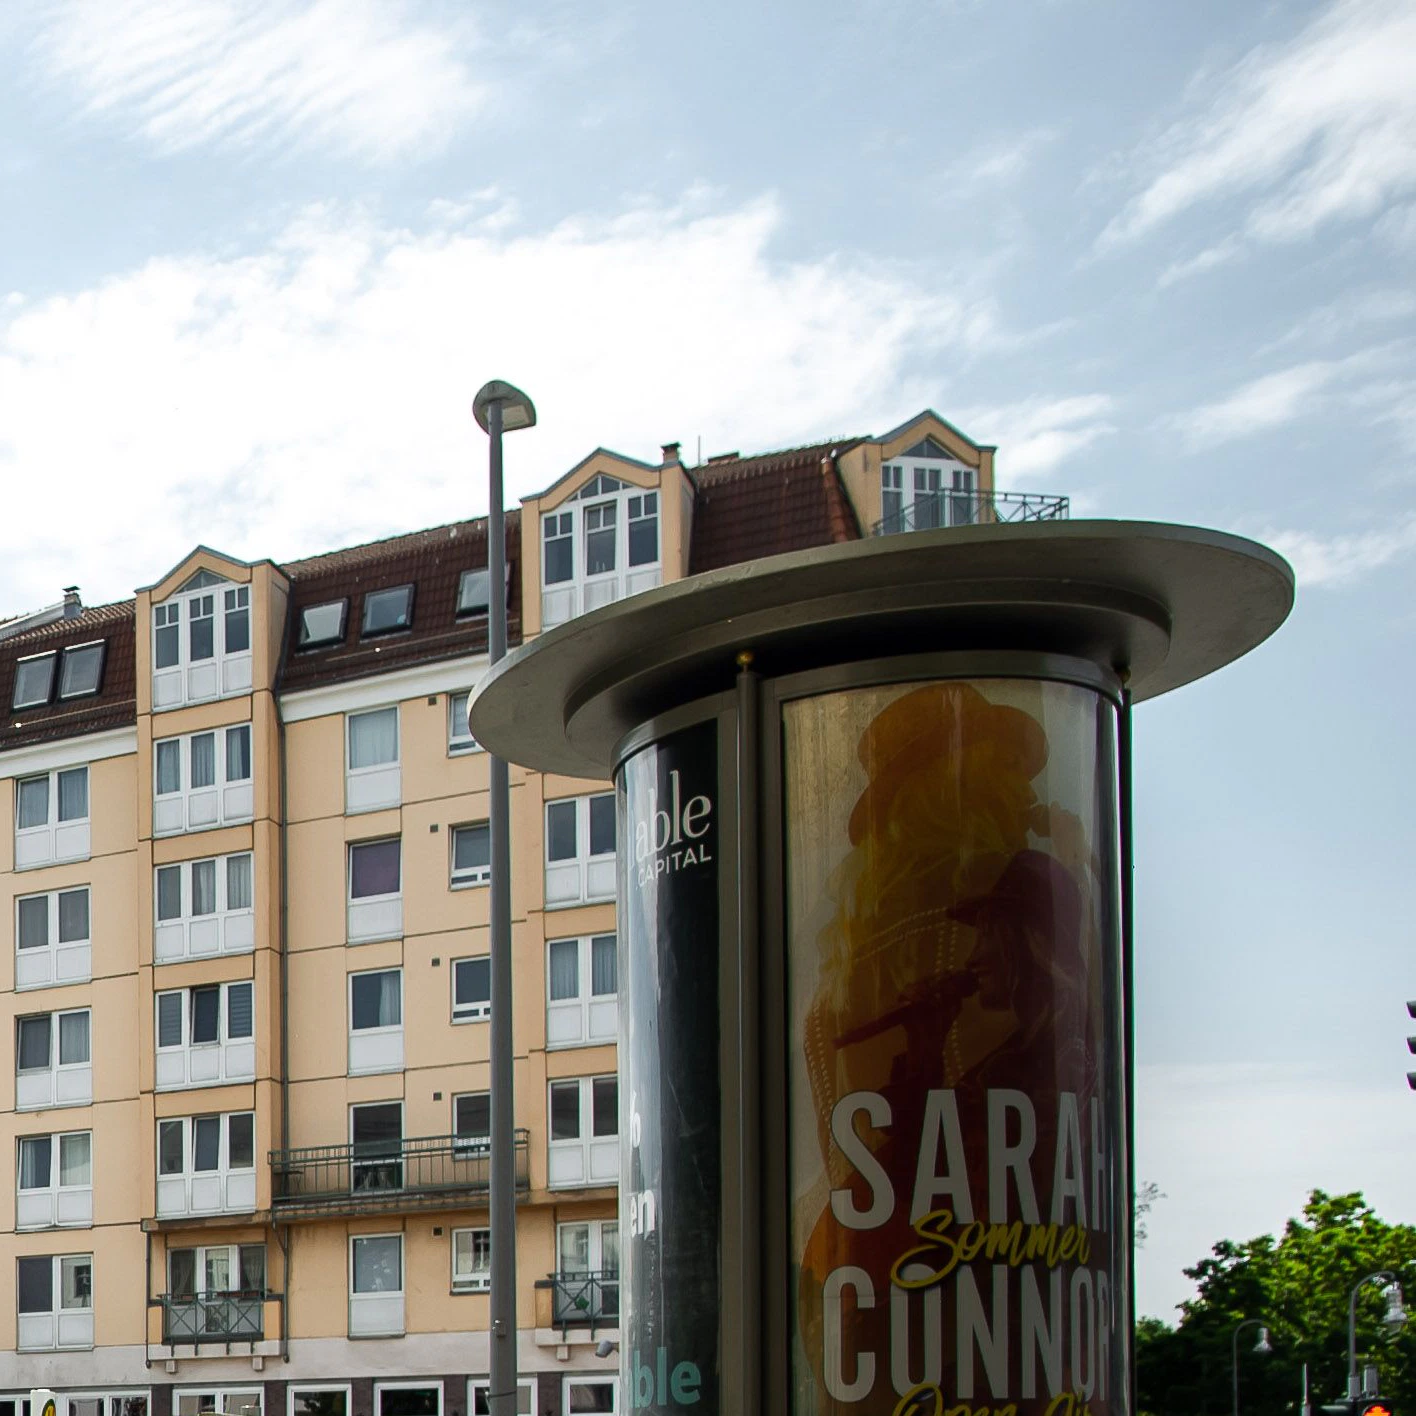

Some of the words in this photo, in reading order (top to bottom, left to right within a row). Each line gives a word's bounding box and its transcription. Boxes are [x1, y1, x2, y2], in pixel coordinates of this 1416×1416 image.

[637, 844, 712, 888] CAPITAL
[830, 1088, 1107, 1233] SARAH
[890, 1208, 1092, 1289] Sommer
